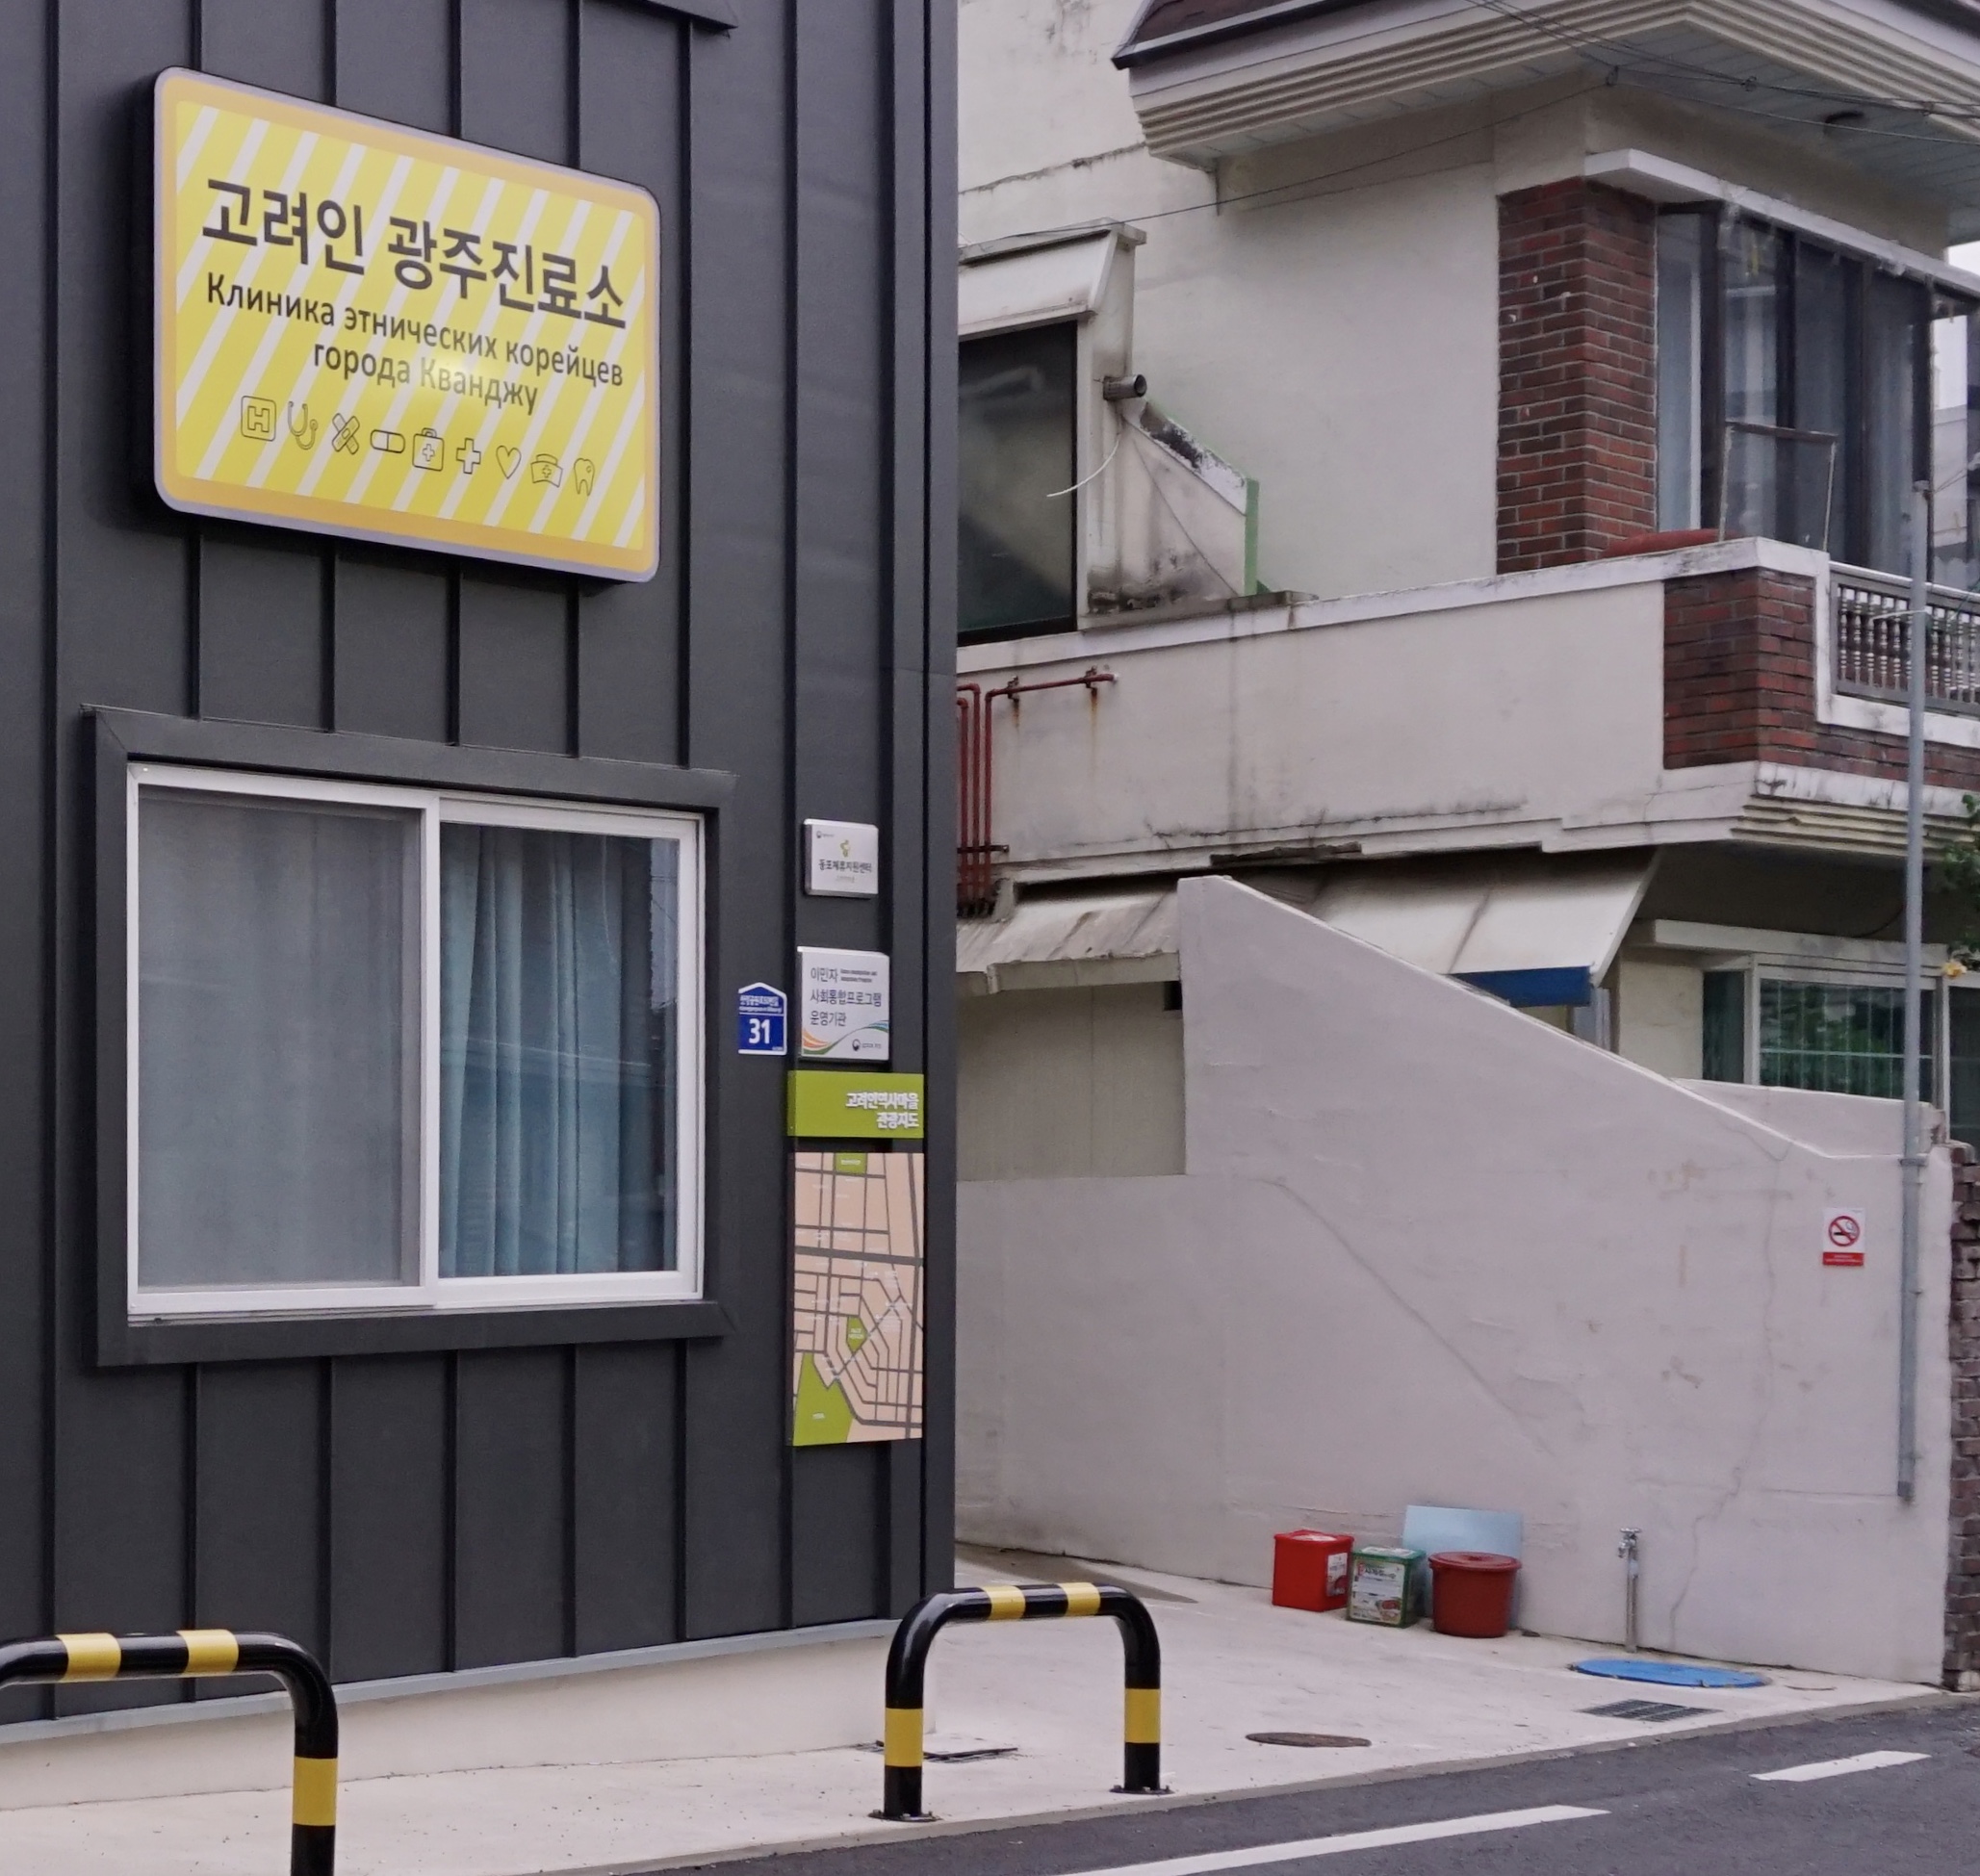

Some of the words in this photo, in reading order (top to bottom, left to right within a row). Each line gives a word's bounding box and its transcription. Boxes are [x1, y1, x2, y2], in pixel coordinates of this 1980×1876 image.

[202, 178, 365, 276] 고려인
[387, 216, 627, 330] 광주진료소
[206, 271, 336, 326] Клиника
[344, 306, 498, 360] этнических
[505, 340, 624, 387] корейцев
[313, 342, 410, 389] города
[420, 356, 538, 417] Кванджу
[810, 966, 838, 983] 이민자
[810, 989, 882, 1008] 사회통합프로그램
[810, 1010, 847, 1027] 운영기관
[748, 1017, 771, 1045] 31
[845, 1092, 919, 1110] 고려인역사마을
[876, 1112, 920, 1129] 관광지도
